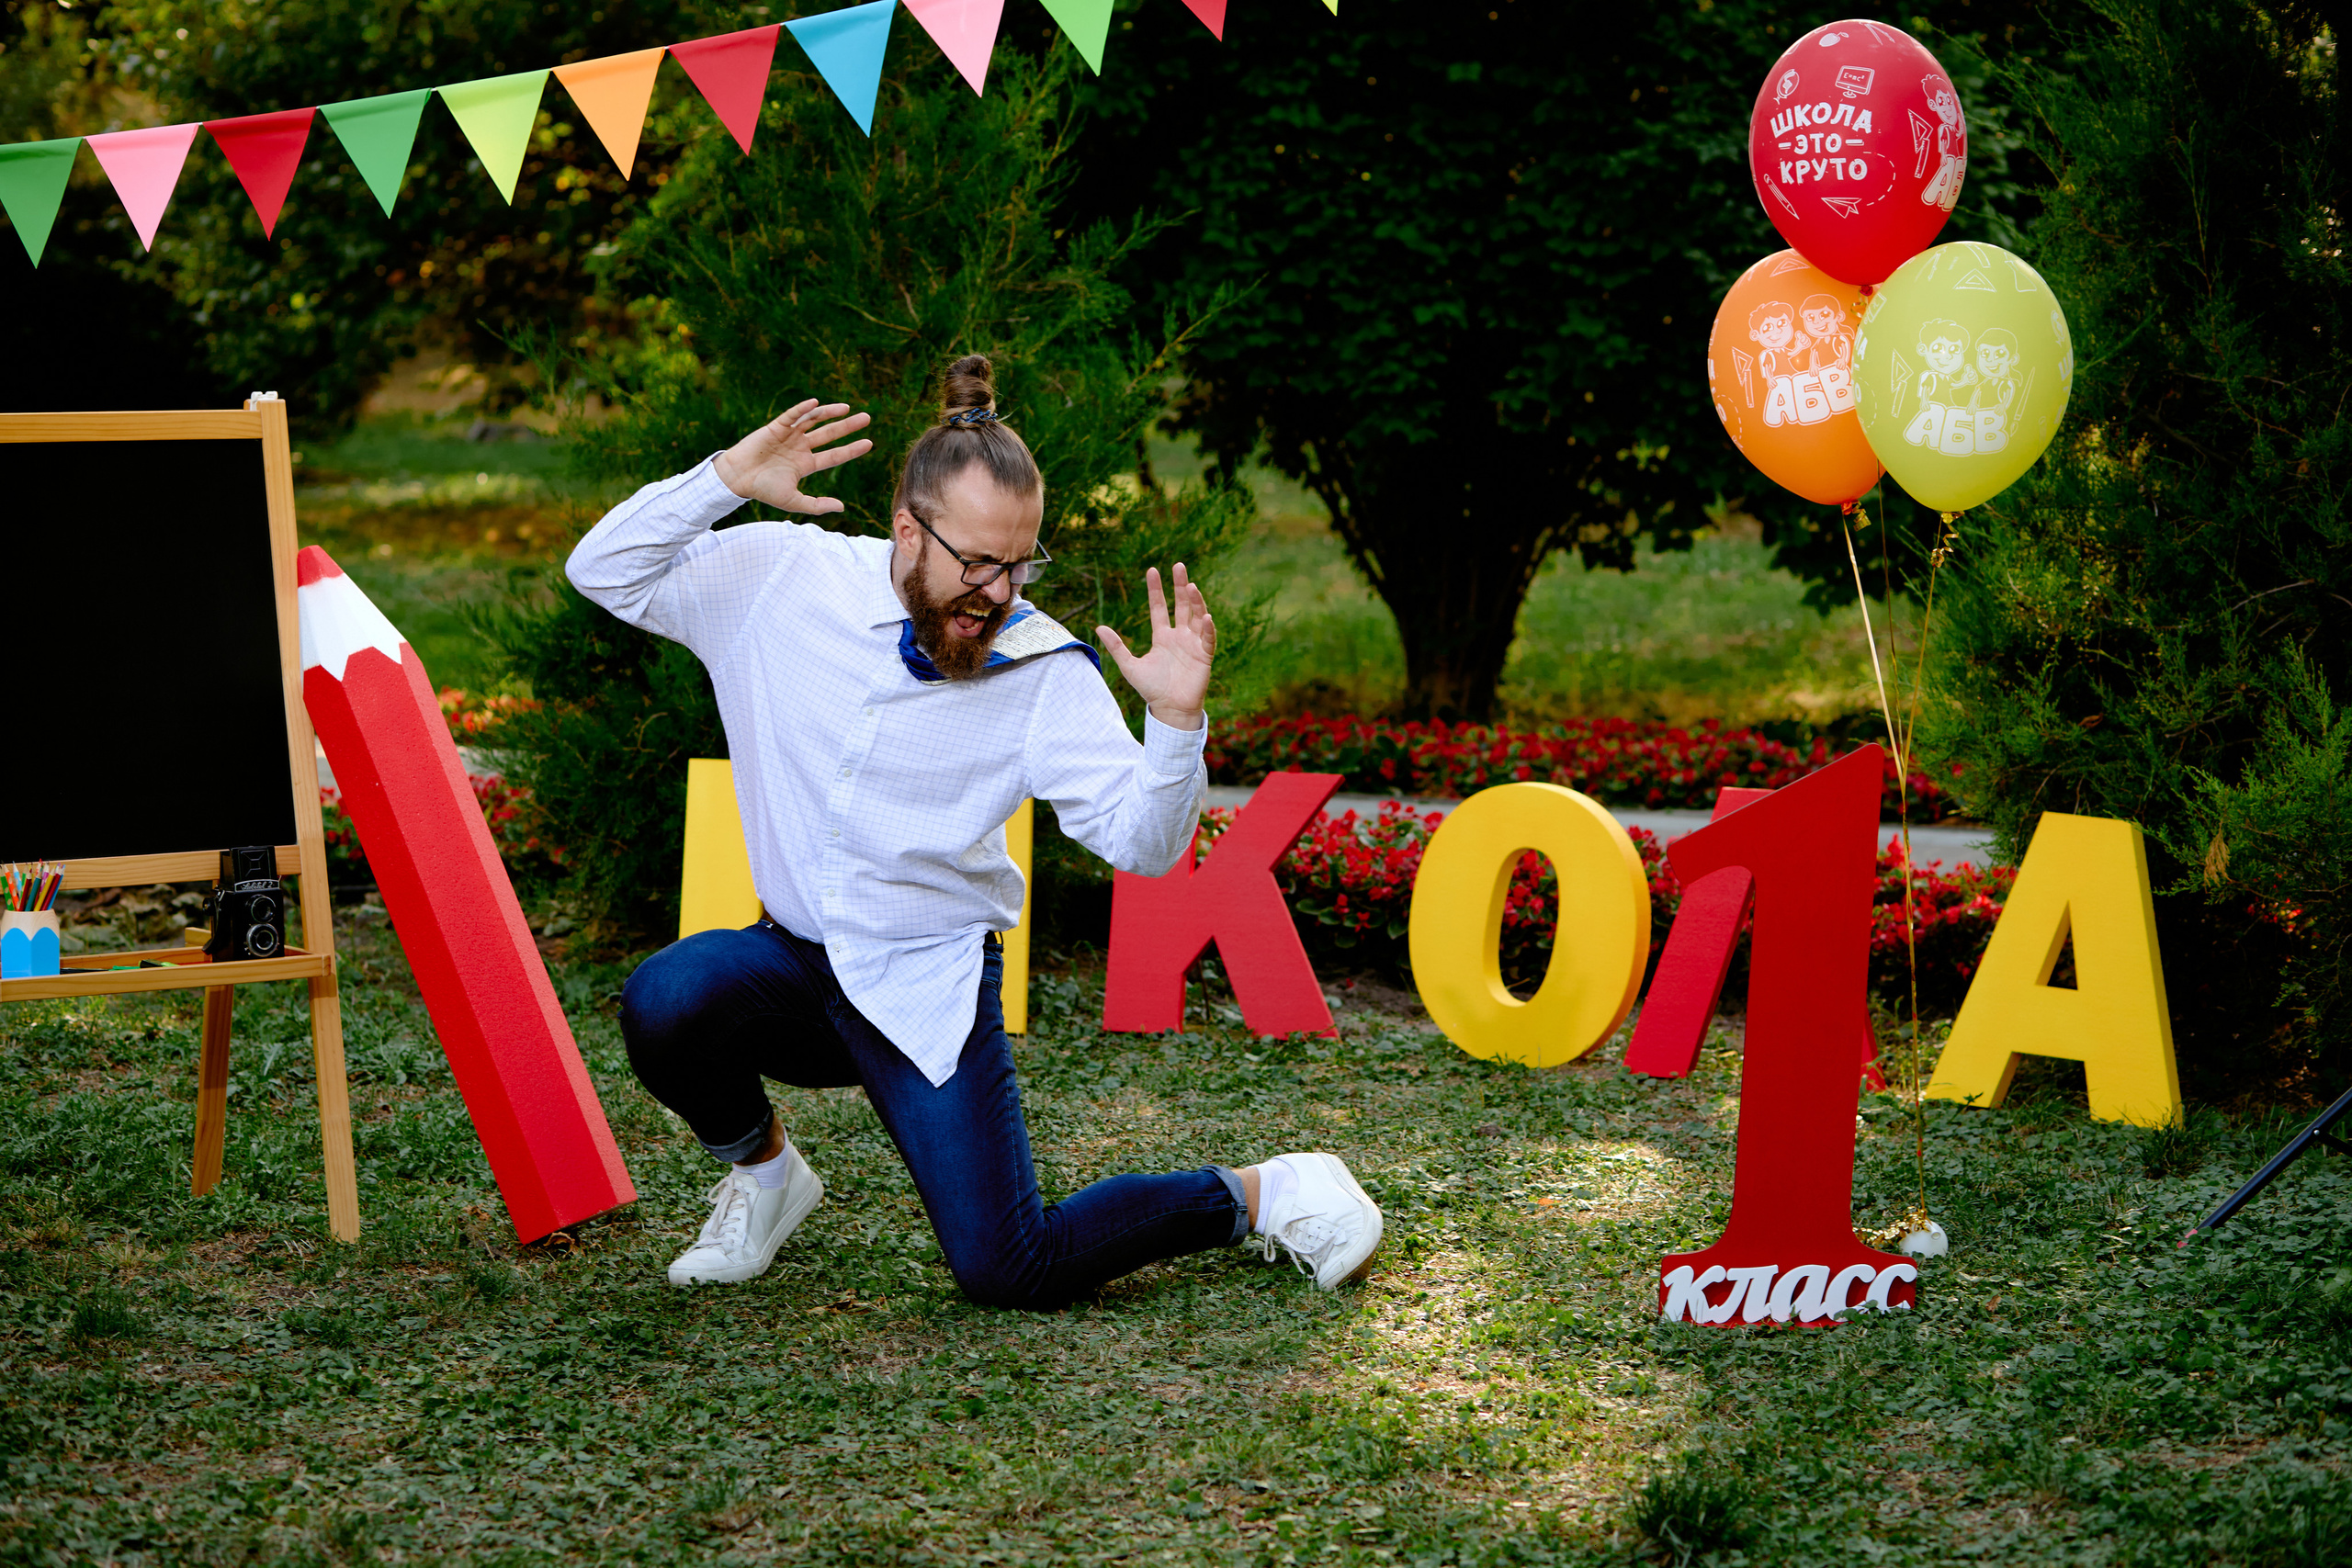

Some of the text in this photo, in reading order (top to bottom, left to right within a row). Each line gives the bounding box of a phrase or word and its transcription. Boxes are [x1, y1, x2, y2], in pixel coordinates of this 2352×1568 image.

[1770, 102, 1872, 139] ШКОЛА
[1780, 157, 1868, 185] КРУТО
[1763, 363, 1856, 428] АБВ
[1903, 400, 2009, 457] АБВ
[1661, 1263, 1918, 1324] класс
